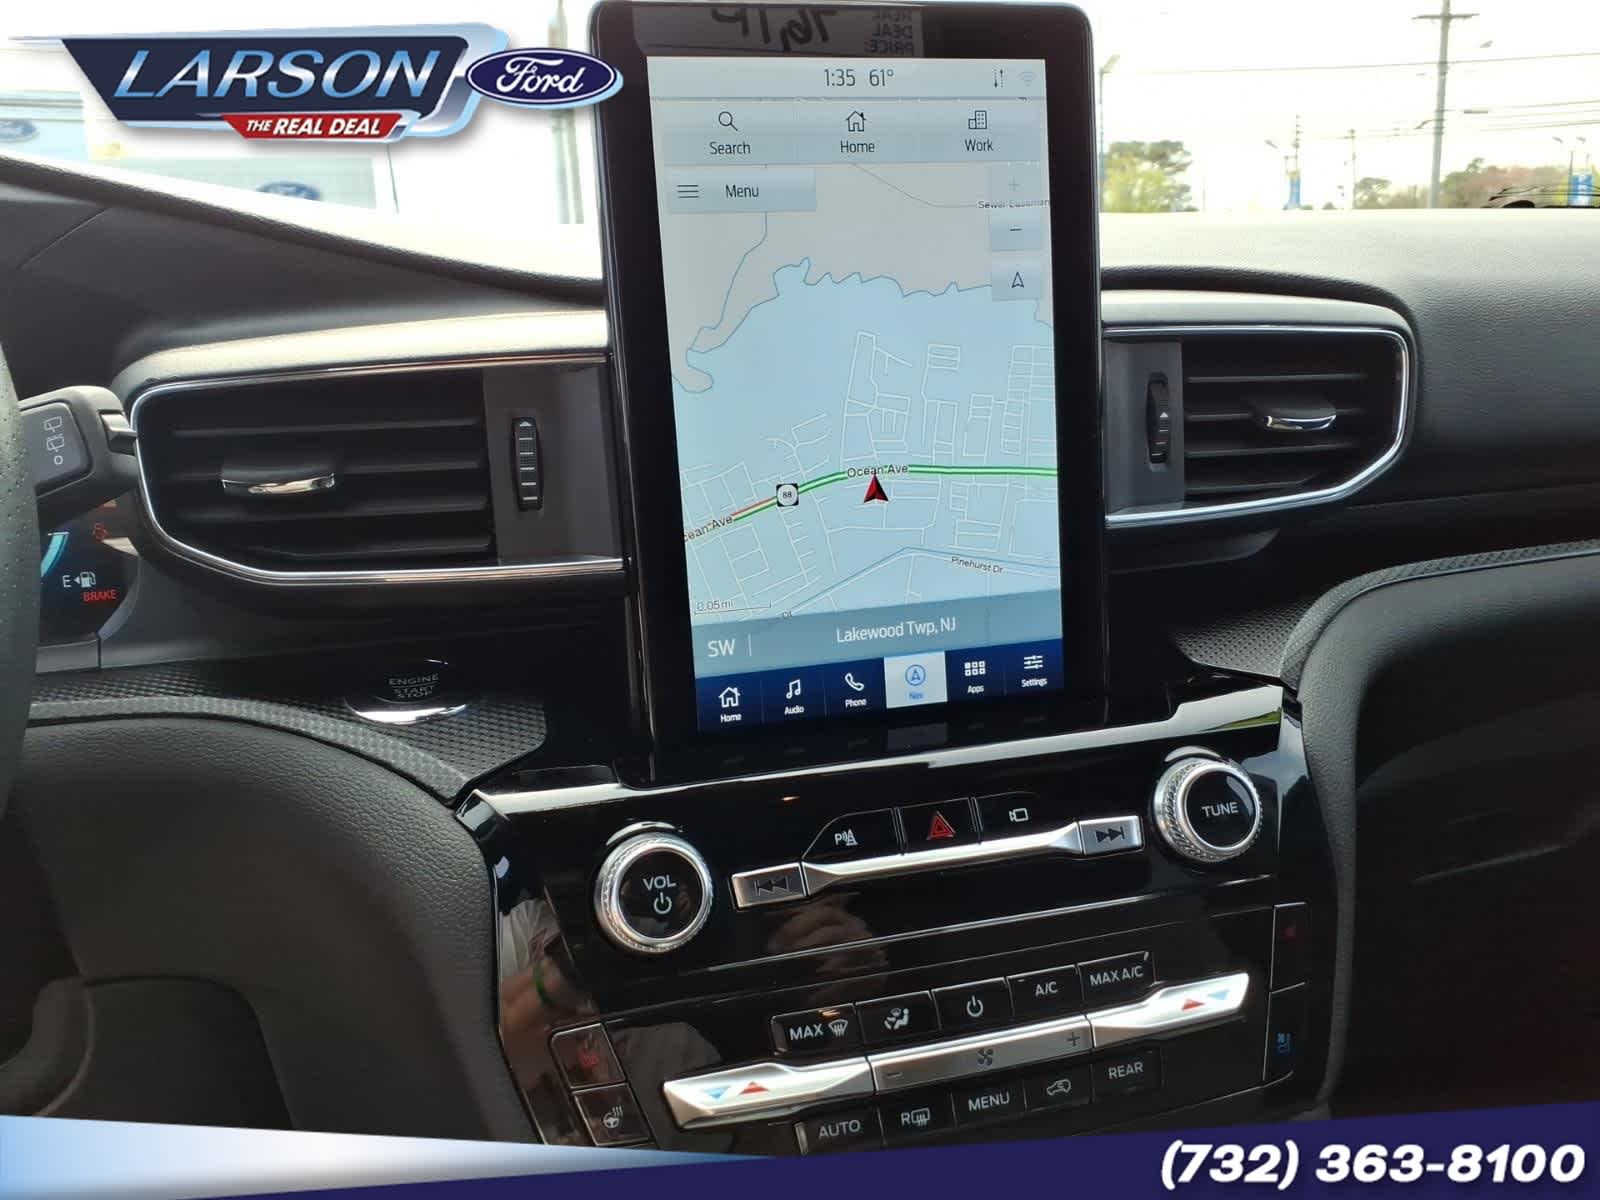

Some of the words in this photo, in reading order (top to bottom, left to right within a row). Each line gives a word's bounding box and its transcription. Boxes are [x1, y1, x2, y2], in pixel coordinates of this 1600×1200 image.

[824, 68, 856, 87] 1:35
[869, 68, 894, 87] 61°
[709, 140, 751, 156] Search
[839, 140, 875, 154] Home
[964, 139, 993, 153] Work
[725, 184, 760, 199] Menu
[847, 465, 886, 478] Ocean
[887, 463, 909, 474] Ave
[683, 521, 710, 542] cean
[711, 514, 733, 530] Ave
[951, 557, 991, 572] Pinehurst
[62, 574, 71, 588] E
[83, 589, 117, 602] BRAKE
[836, 622, 904, 643] Lakewood
[907, 620, 938, 638] Twp,
[941, 617, 956, 632] NJ
[707, 639, 736, 657] SW
[389, 673, 438, 685] ENGINE
[1021, 677, 1048, 688] Settings
[967, 685, 985, 694] Apps
[784, 705, 805, 716] Audio
[845, 698, 867, 709] Phone
[720, 713, 742, 724] Home
[1202, 802, 1238, 817] TUNE
[643, 875, 676, 891] VOL
[1090, 970, 1119, 986] MAX
[1119, 965, 1144, 980] A/C
[1034, 981, 1058, 997] A/C
[789, 1023, 823, 1040] MAX
[1109, 1061, 1144, 1079] REAR
[968, 1092, 1010, 1112] MENU
[818, 1119, 861, 1139] AUTO
